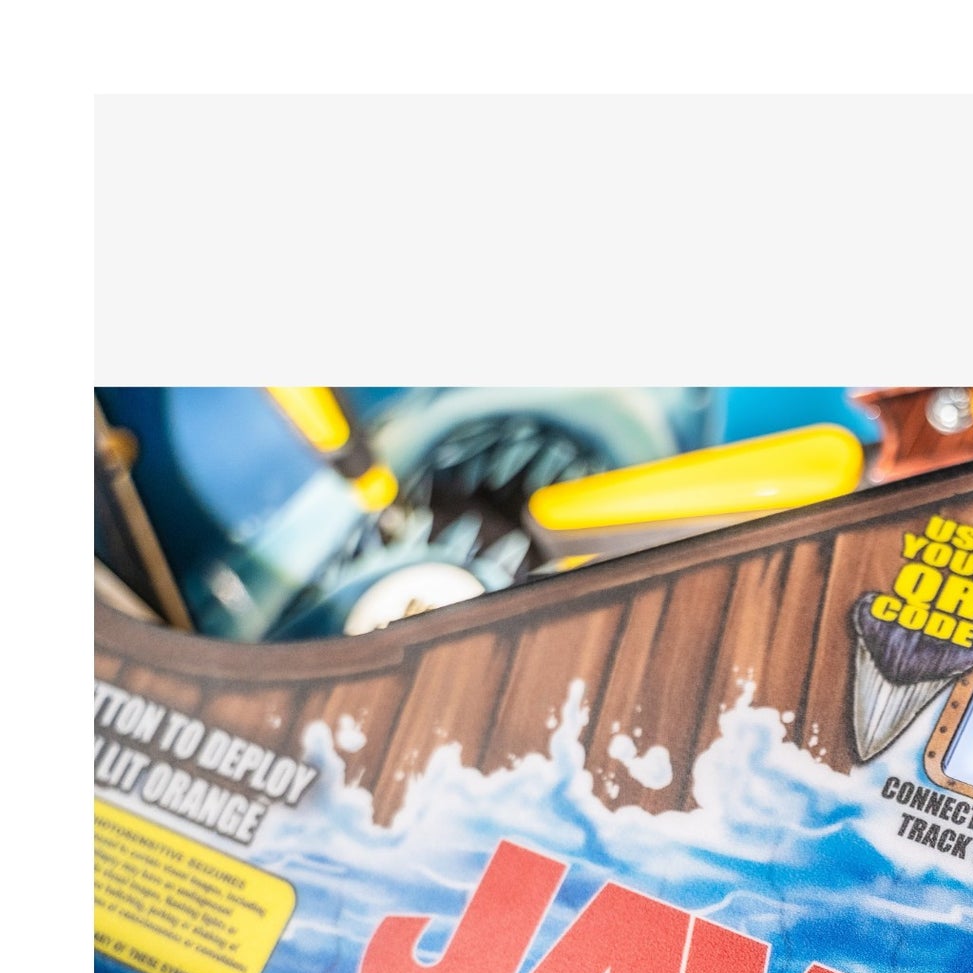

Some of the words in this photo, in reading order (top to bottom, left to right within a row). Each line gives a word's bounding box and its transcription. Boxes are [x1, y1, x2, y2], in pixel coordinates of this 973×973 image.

[96, 741, 151, 791] LIT
[143, 762, 267, 844] ORANGE
[160, 711, 205, 760] TO
[199, 730, 318, 803] DEPLOY
[896, 812, 967, 860] TRACK
